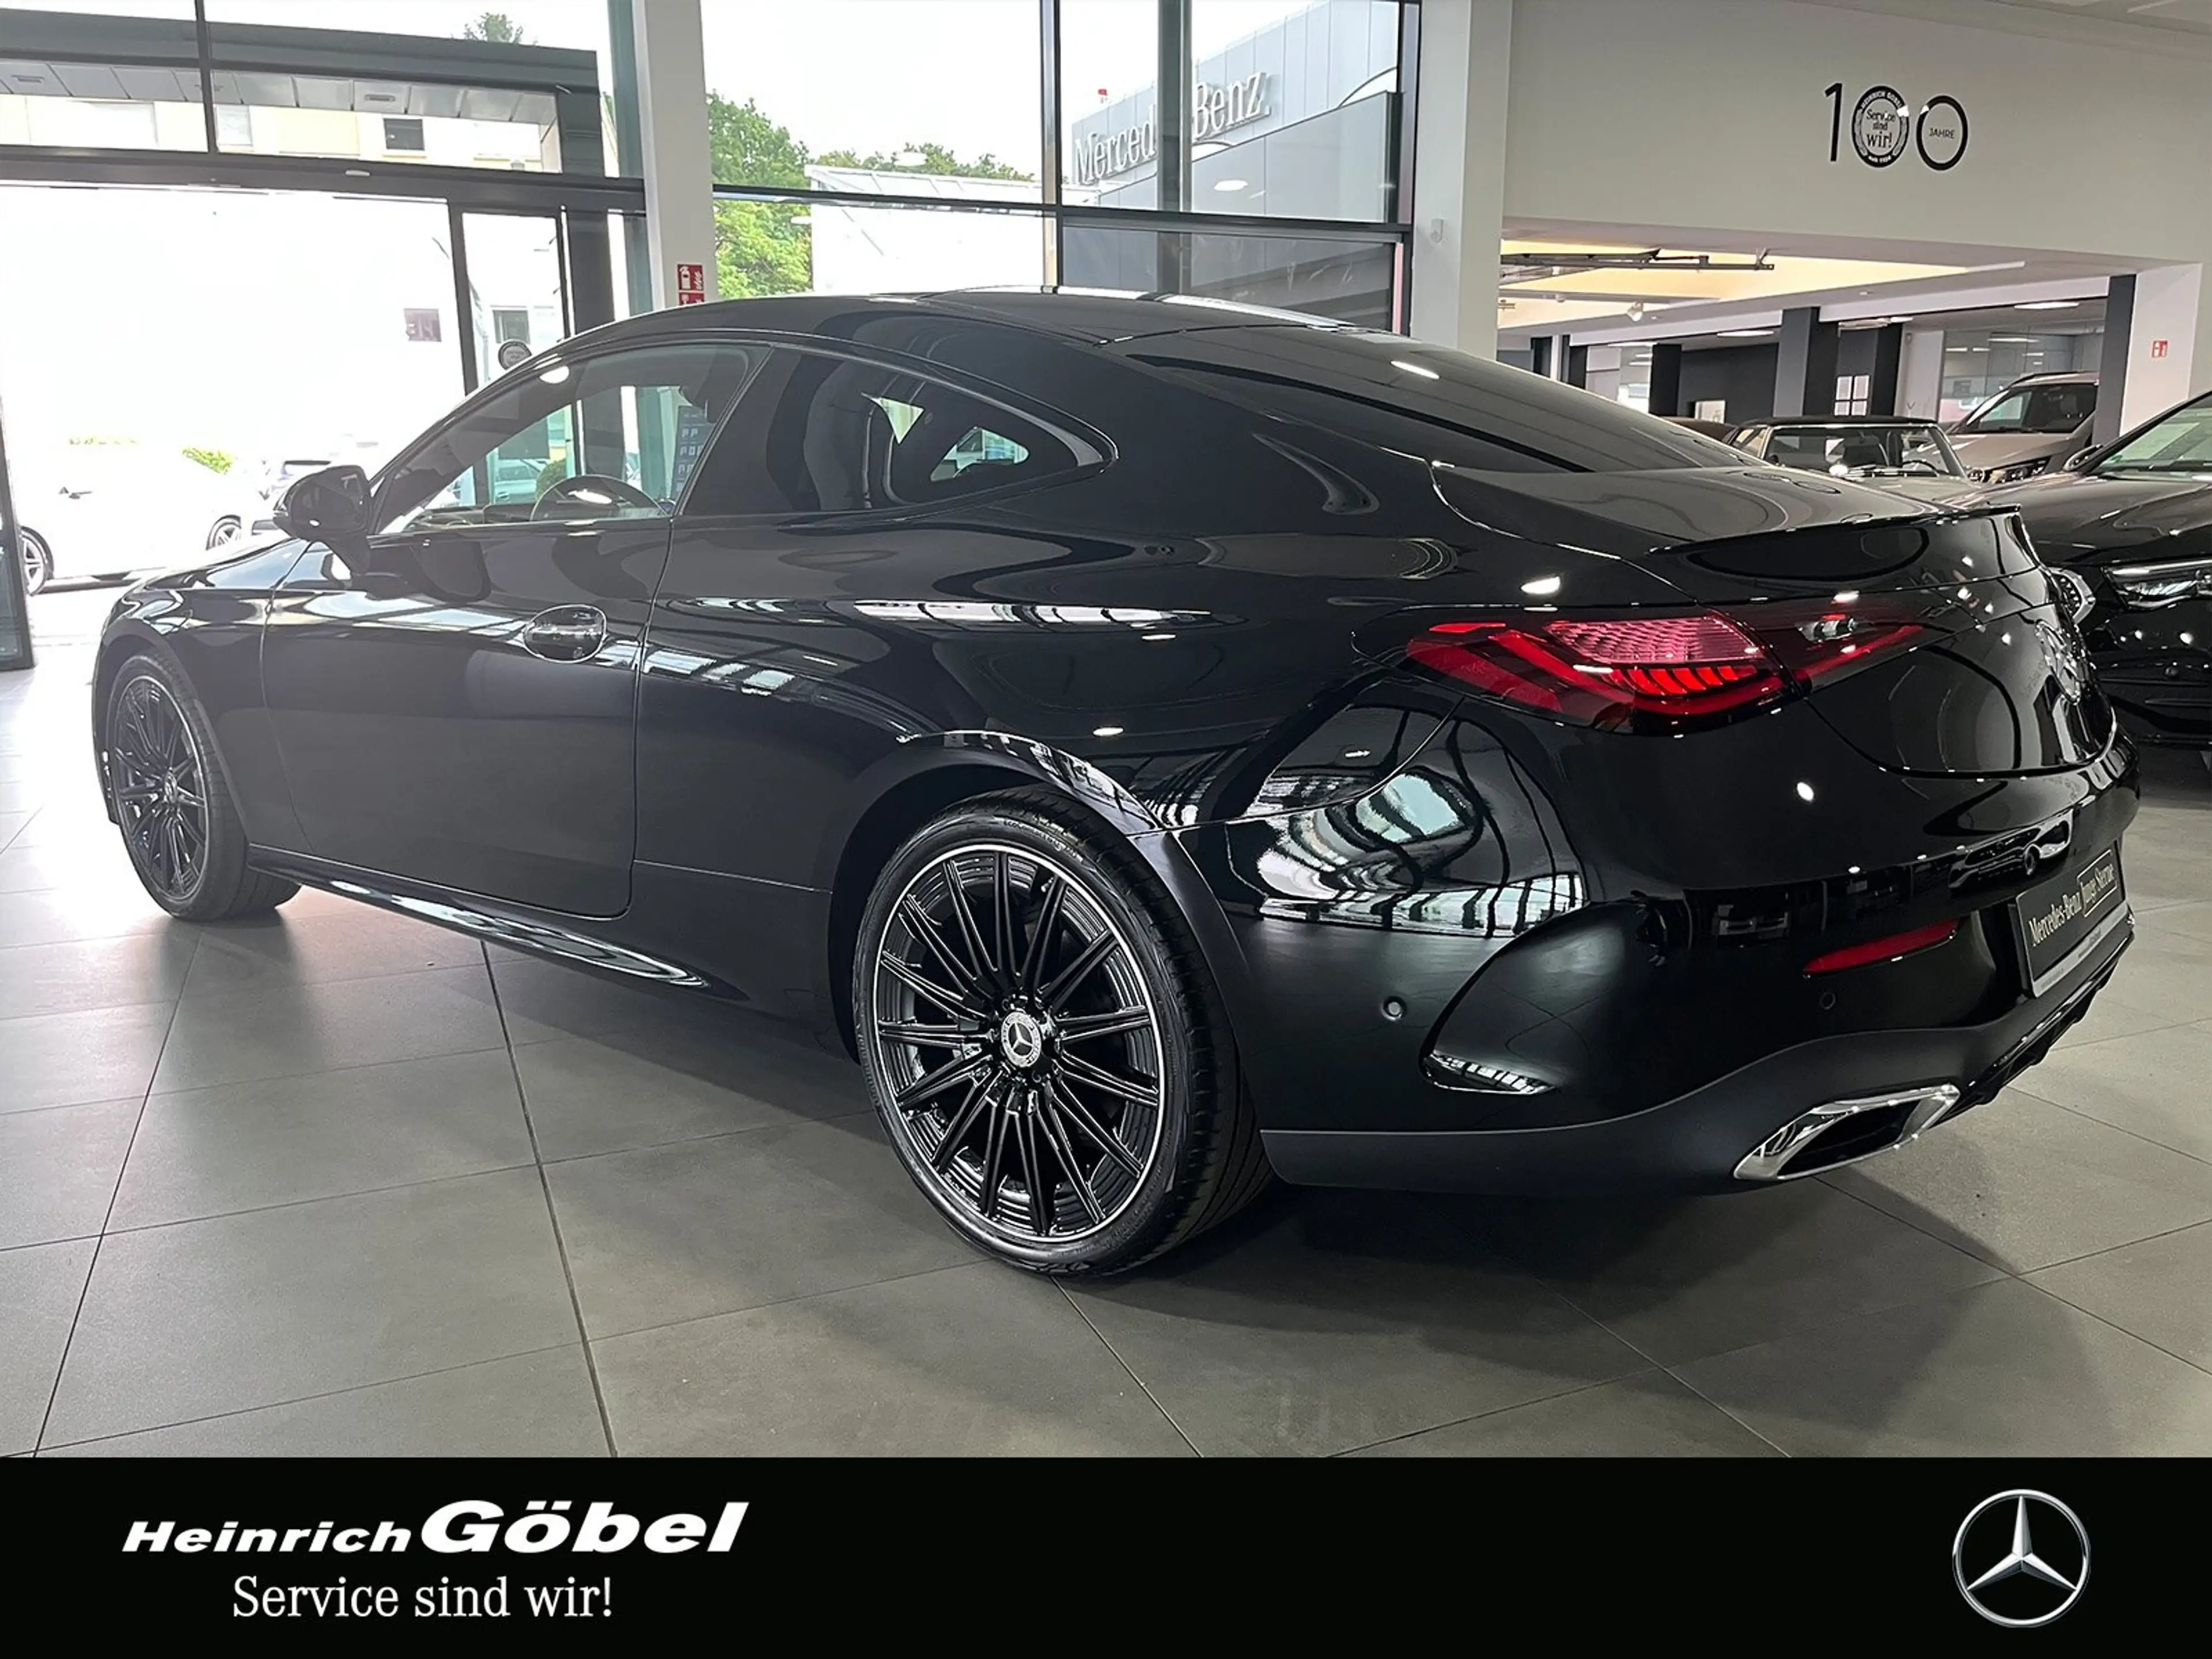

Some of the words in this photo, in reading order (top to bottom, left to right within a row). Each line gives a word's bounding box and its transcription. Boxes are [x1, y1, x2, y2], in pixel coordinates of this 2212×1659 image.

[1866, 108, 1896, 123] Service
[1075, 71, 1271, 185] MercedBenz
[1824, 82, 1968, 171] 100
[1929, 127, 1955, 139] JAHRE
[1866, 131, 1892, 148] wir!
